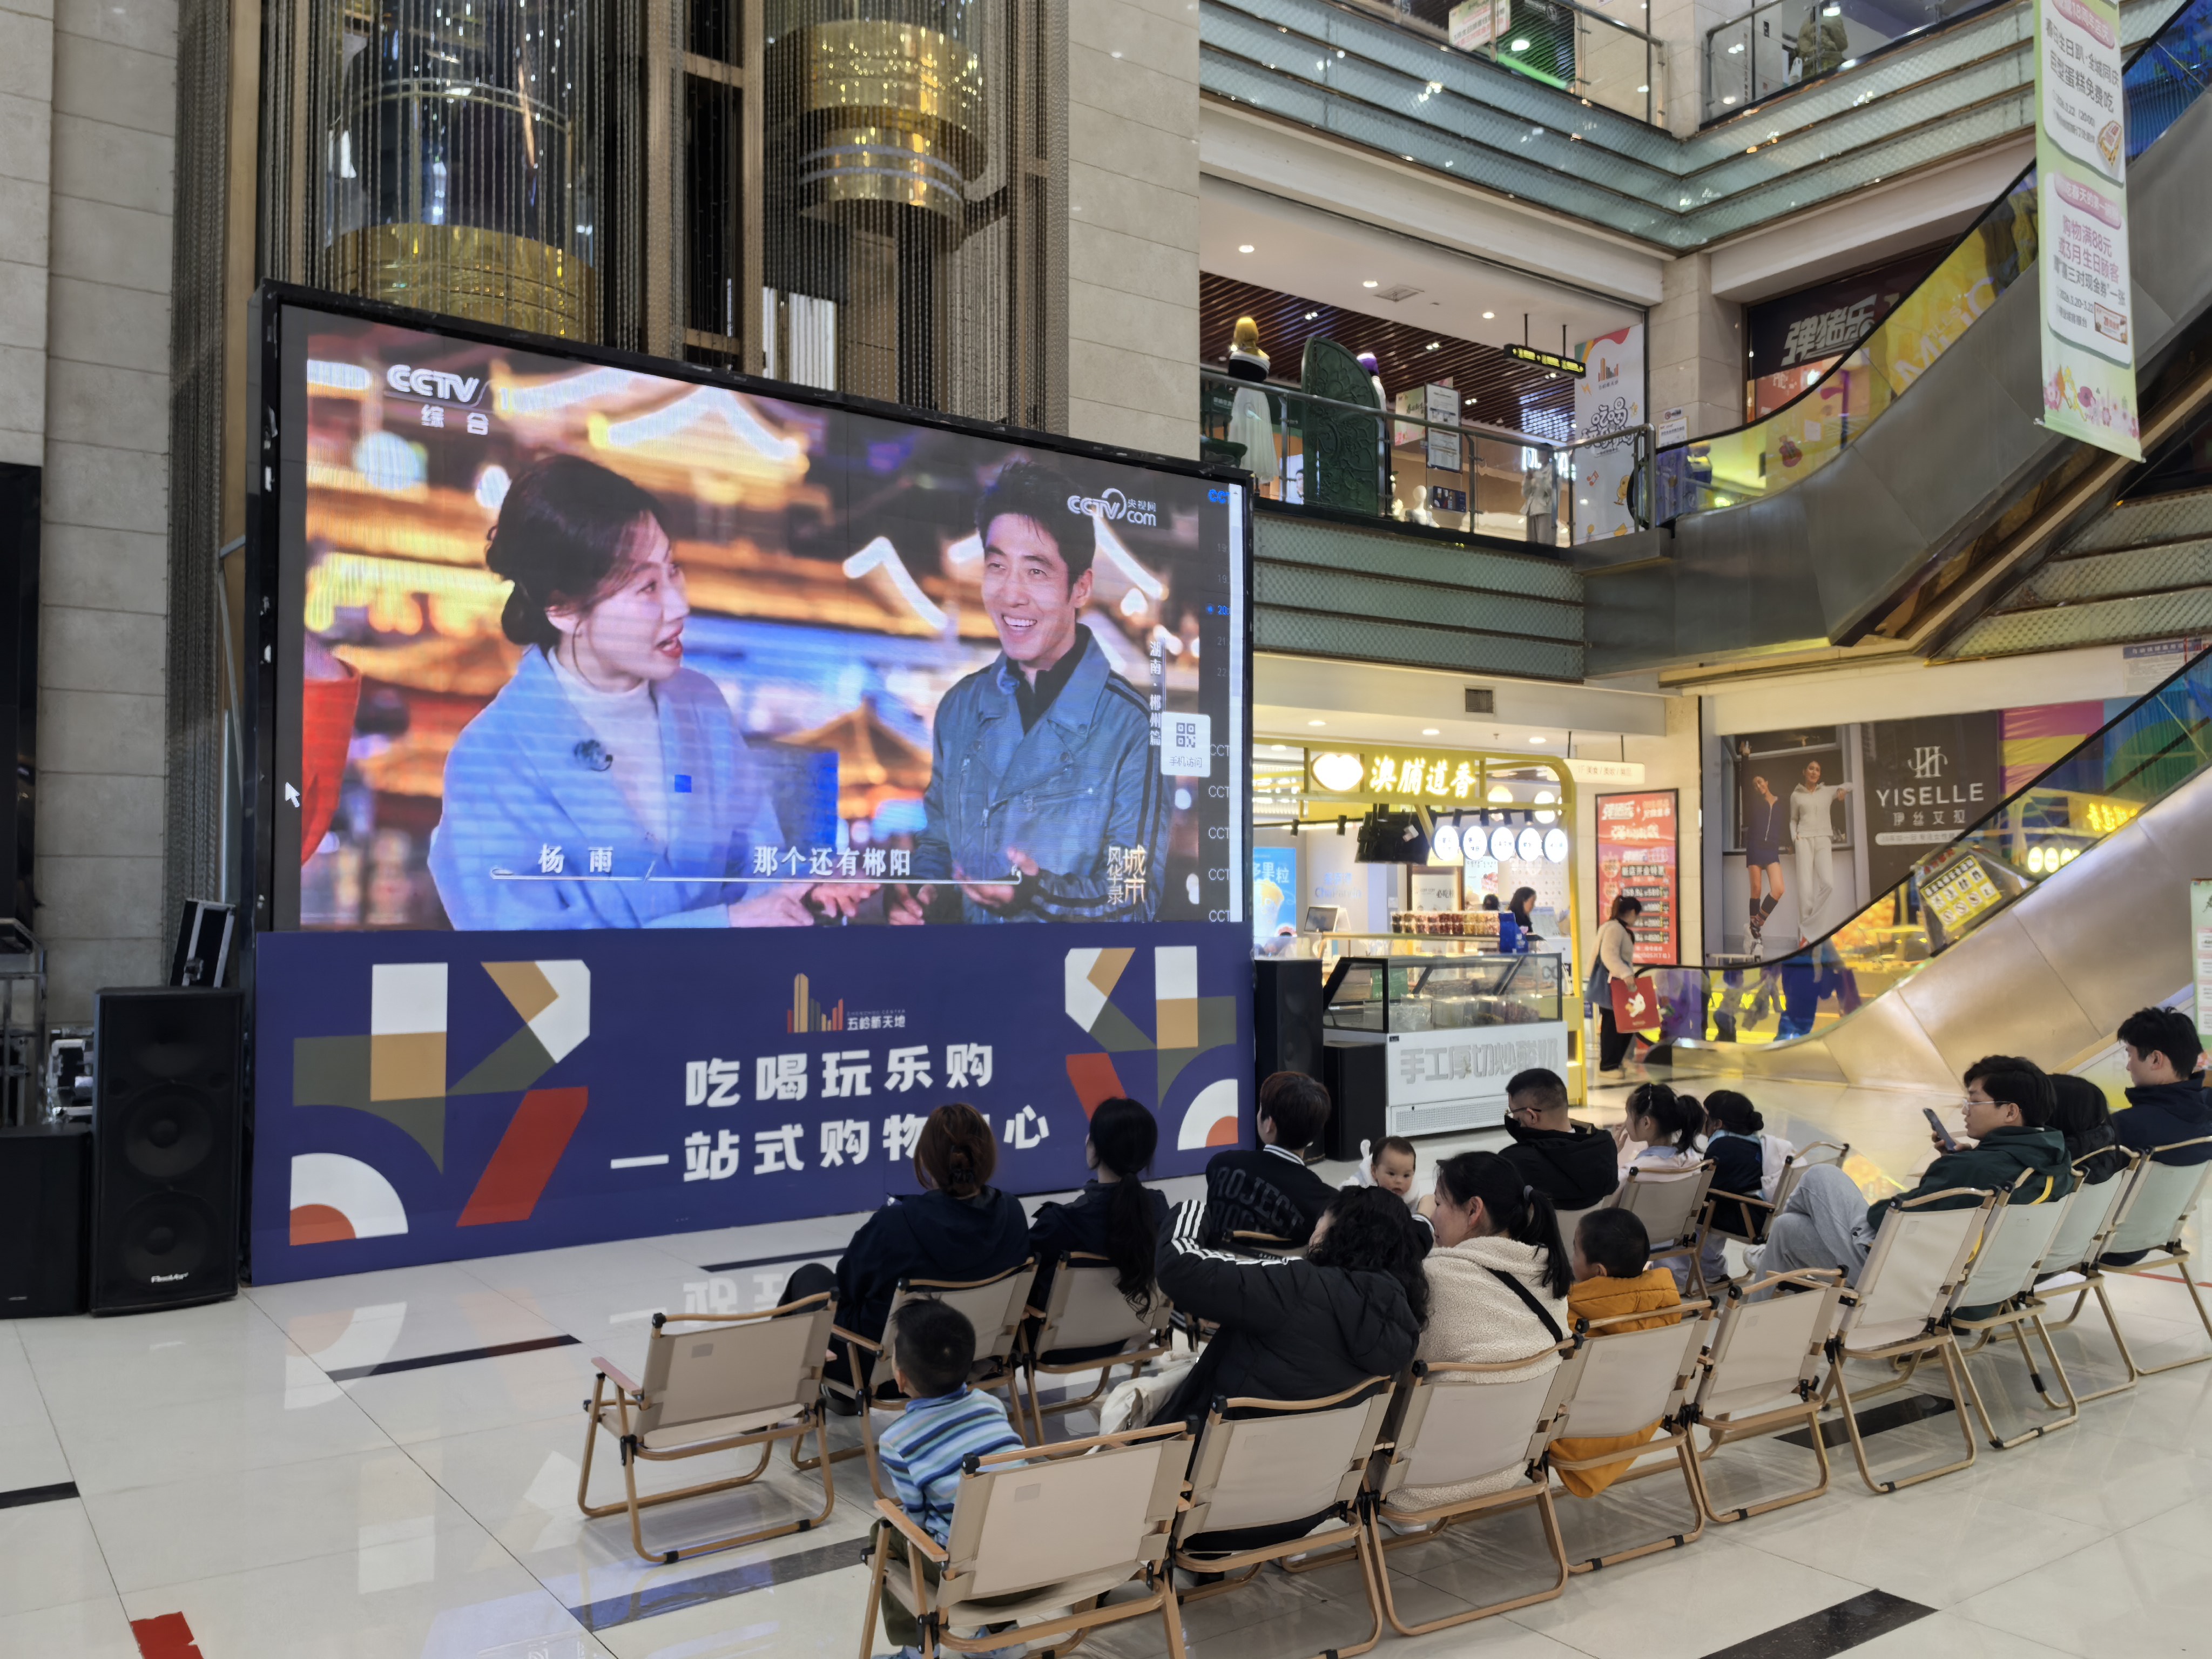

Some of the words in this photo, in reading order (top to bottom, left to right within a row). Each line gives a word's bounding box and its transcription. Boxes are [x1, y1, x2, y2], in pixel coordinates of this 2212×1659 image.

[2063, 214, 2112, 258] 购物满88元
[387, 364, 480, 402] CCTV
[1067, 495, 1121, 520] CCTV
[1128, 498, 1156, 512] 央视网
[1170, 756, 1202, 768] 手机访问
[1876, 783, 1984, 808] YISELLE
[538, 843, 613, 874] 杨雨
[753, 846, 911, 876] 那个还有郴阳
[1123, 844, 1147, 905] 城市
[847, 1015, 906, 1031] 五岭新天地
[685, 1043, 993, 1108] 吃喝玩乐购
[610, 1104, 1049, 1182] 一站式购物心
[1210, 1166, 1305, 1237] ROJECT
